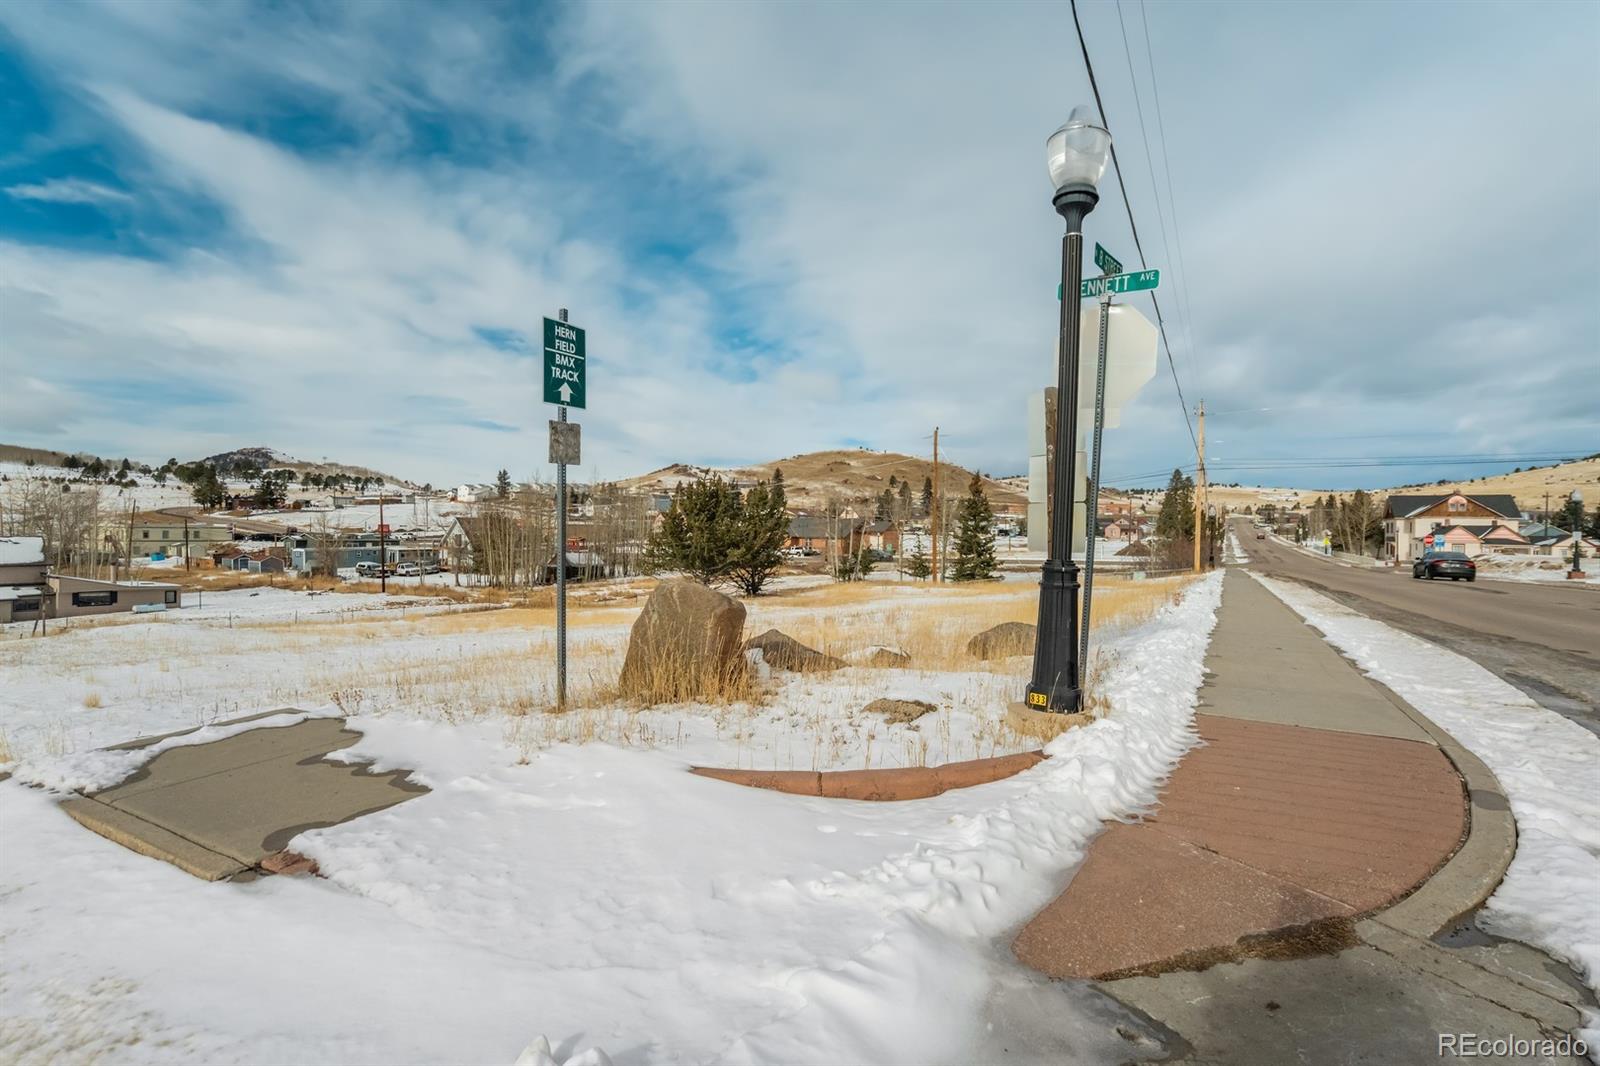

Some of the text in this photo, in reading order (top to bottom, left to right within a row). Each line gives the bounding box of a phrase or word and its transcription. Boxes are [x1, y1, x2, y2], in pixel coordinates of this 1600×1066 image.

[1081, 271, 1156, 297] ENNETT AVE
[554, 325, 576, 340] HERN
[555, 339, 576, 353] FIELD
[555, 353, 576, 368] BMX
[551, 366, 579, 383] TRACK
